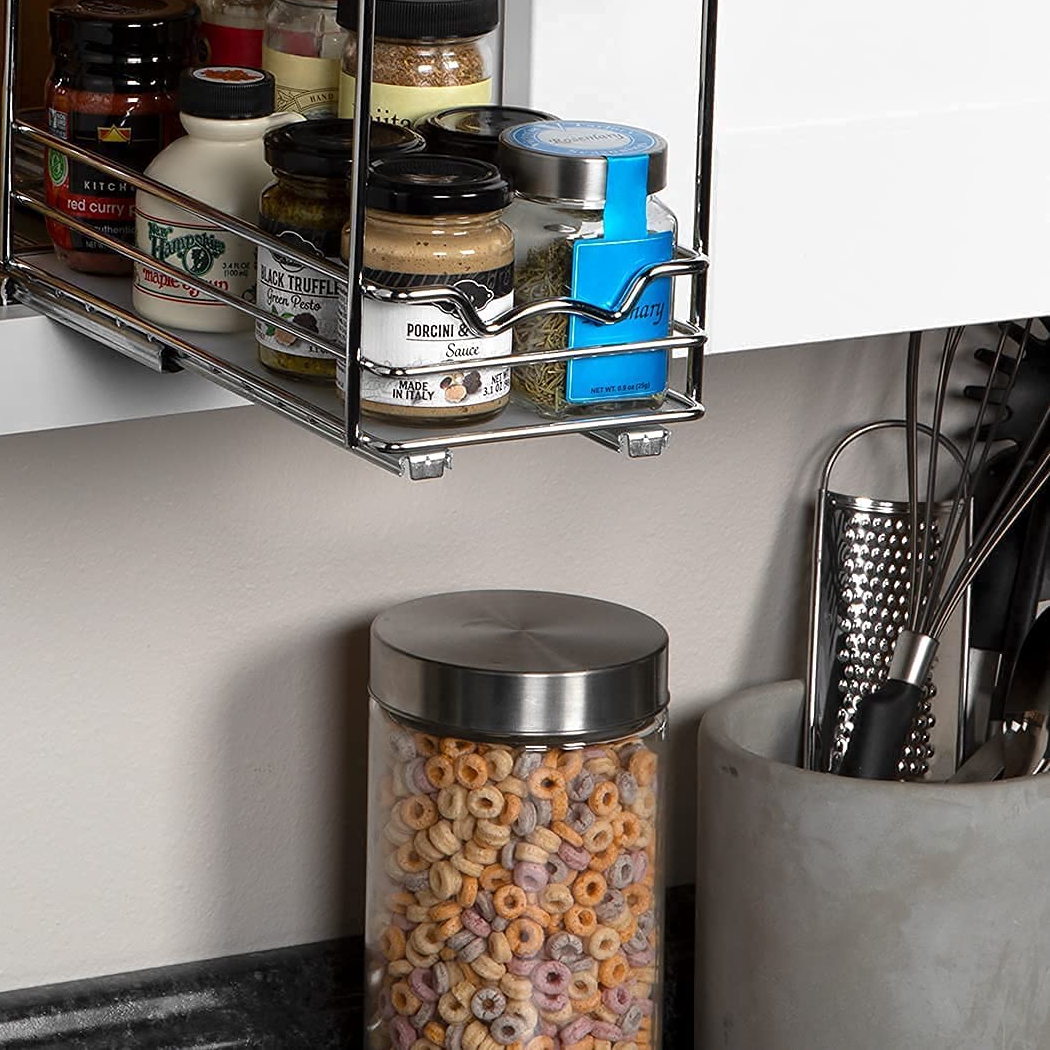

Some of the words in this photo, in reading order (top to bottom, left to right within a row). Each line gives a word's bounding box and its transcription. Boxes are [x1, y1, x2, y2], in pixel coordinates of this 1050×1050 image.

[67, 198, 86, 211] red
[89, 202, 124, 217] curry
[260, 264, 285, 288] BLACK
[288, 274, 340, 295] TRUFFLE
[267, 288, 289, 306] Green
[291, 294, 322, 311] Pesto
[407, 323, 454, 338] PORCINI
[458, 323, 469, 337] &
[445, 342, 480, 358] Sauce
[399, 380, 428, 392] MADE
[591, 386, 604, 394] NET
[392, 388, 403, 399] IN
[405, 390, 435, 401] ITALY
